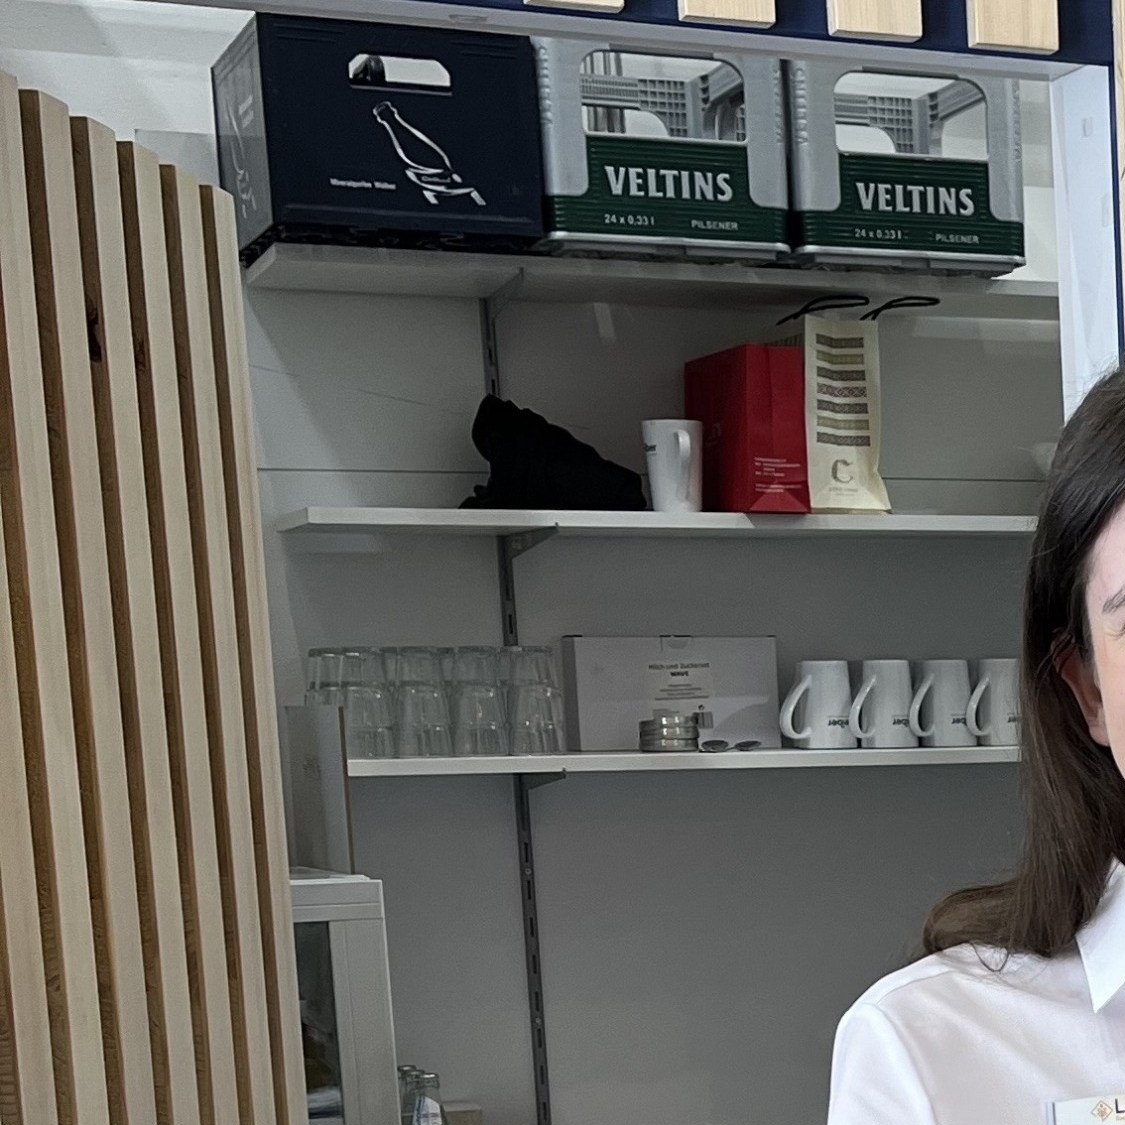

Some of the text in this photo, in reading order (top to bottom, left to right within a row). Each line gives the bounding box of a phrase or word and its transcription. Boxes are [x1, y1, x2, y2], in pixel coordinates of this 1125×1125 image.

[604, 165, 733, 201] VELTINS
[855, 182, 975, 217] VELTINS
[604, 213, 617, 224] 24
[691, 219, 739, 231] PILSENER
[854, 228, 867, 238] 24
[935, 233, 980, 245] PILSENER
[831, 459, 854, 484] C
